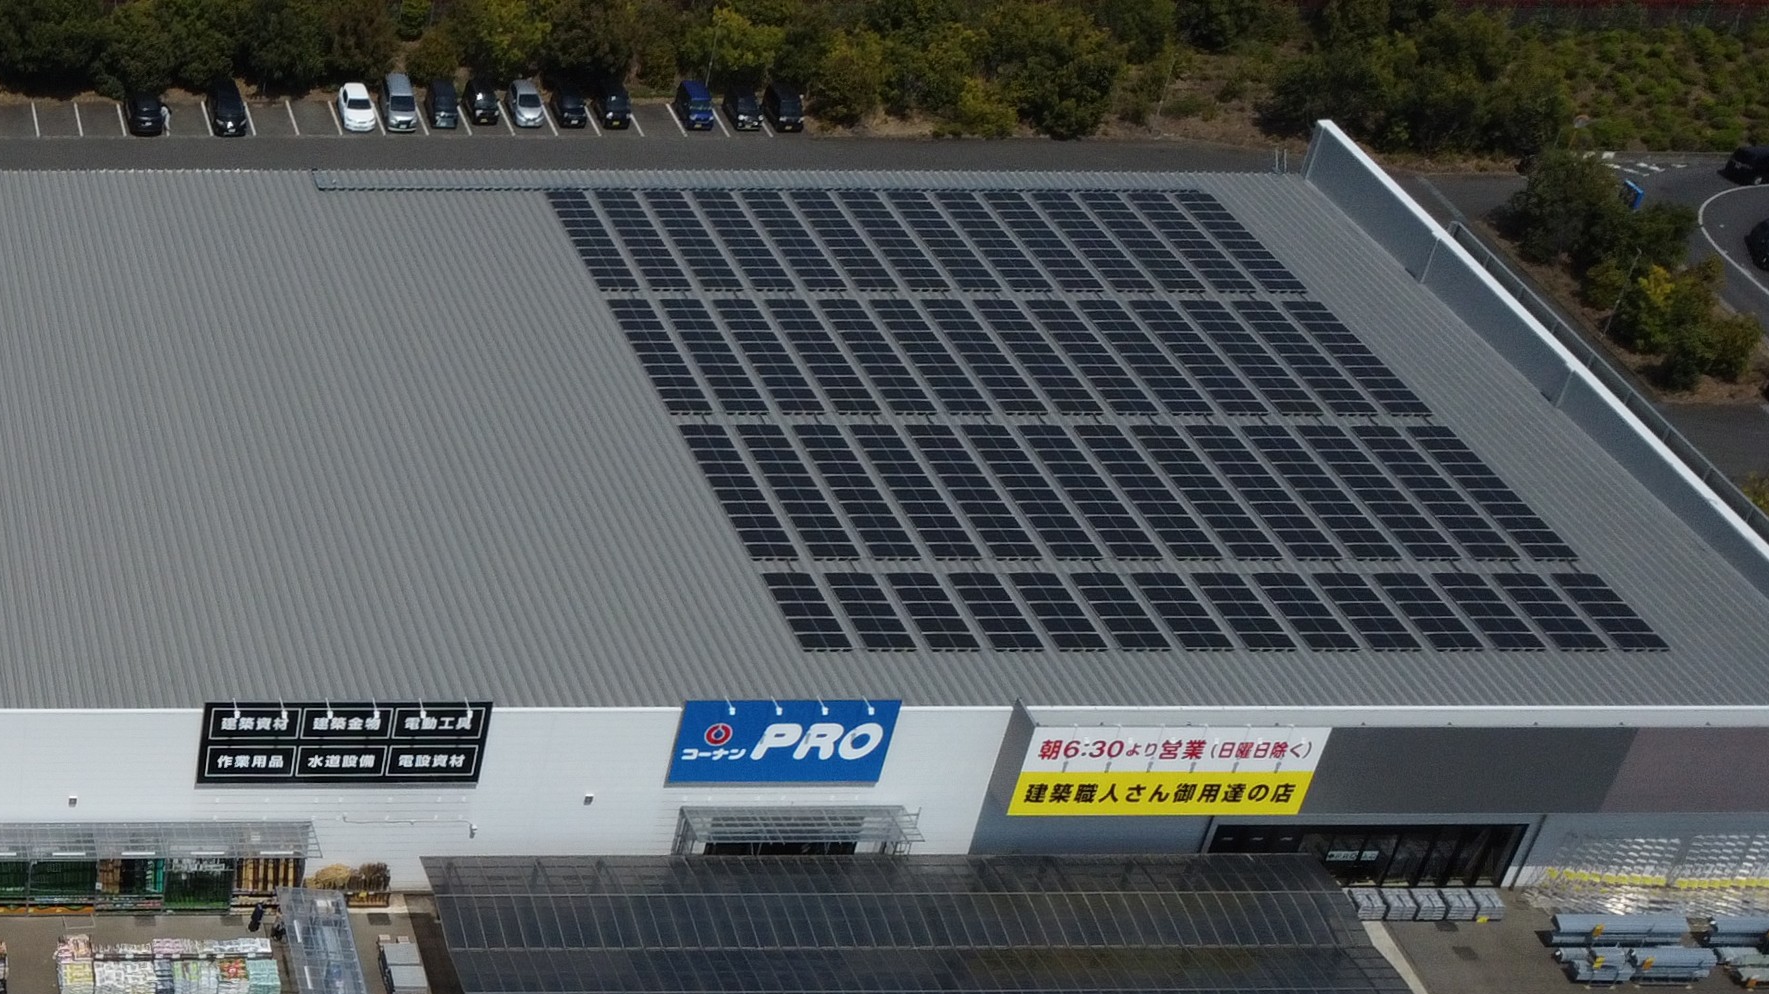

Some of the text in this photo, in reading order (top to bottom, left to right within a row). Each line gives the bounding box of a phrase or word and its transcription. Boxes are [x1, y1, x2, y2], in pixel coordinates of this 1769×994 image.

[221, 716, 289, 731] 建築資材
[312, 715, 381, 731] 建築金物
[404, 716, 472, 731] 電動工具
[750, 722, 884, 761] PRO
[217, 754, 285, 768] 作業用品
[307, 754, 375, 768] 水道設備
[398, 754, 466, 768] 電設資材
[681, 748, 747, 761] コーナン
[1023, 783, 1297, 803] 建築職人さん御用達の店
